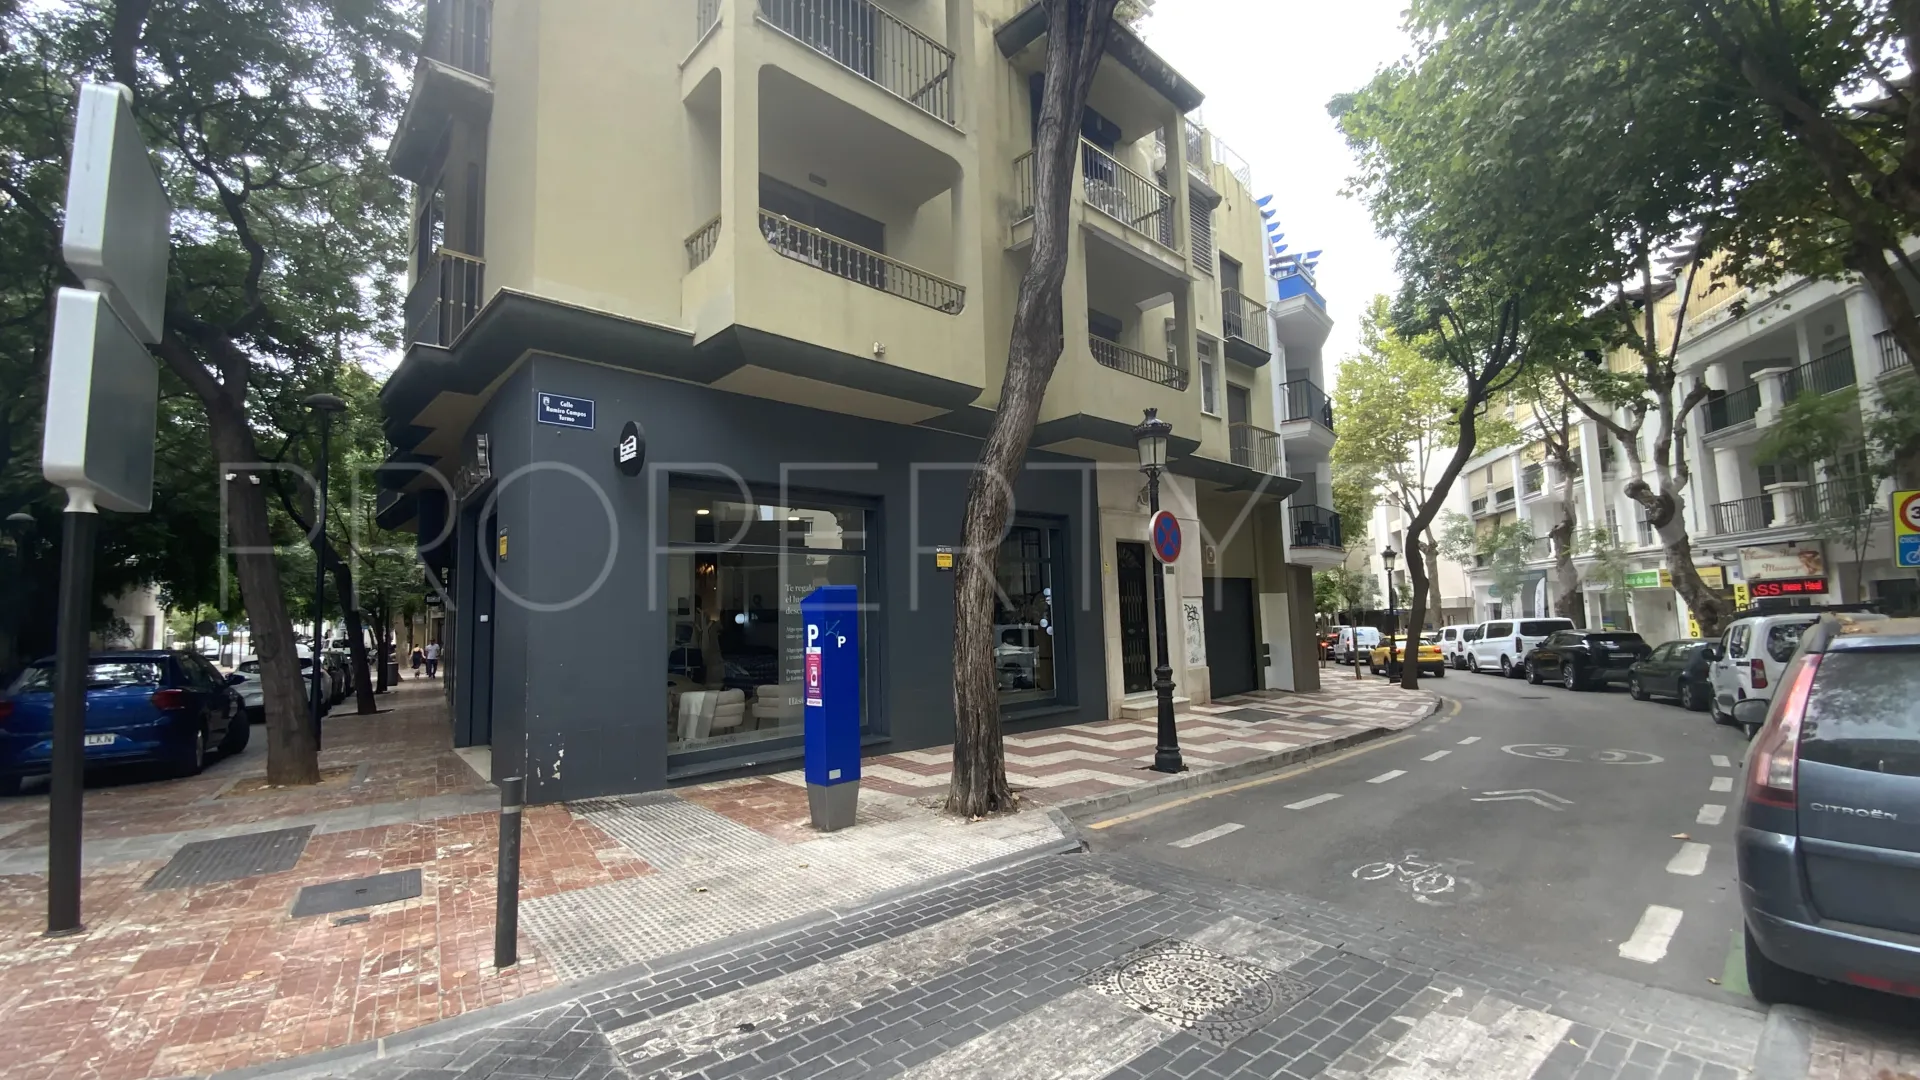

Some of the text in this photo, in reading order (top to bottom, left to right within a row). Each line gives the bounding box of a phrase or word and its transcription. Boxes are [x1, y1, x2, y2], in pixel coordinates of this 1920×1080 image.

[546, 405, 587, 417] Ramiro Campos
[559, 414, 575, 422] Turmo
[807, 624, 819, 647] P
[837, 635, 847, 648] P
[1810, 802, 1898, 821] CITROËN
